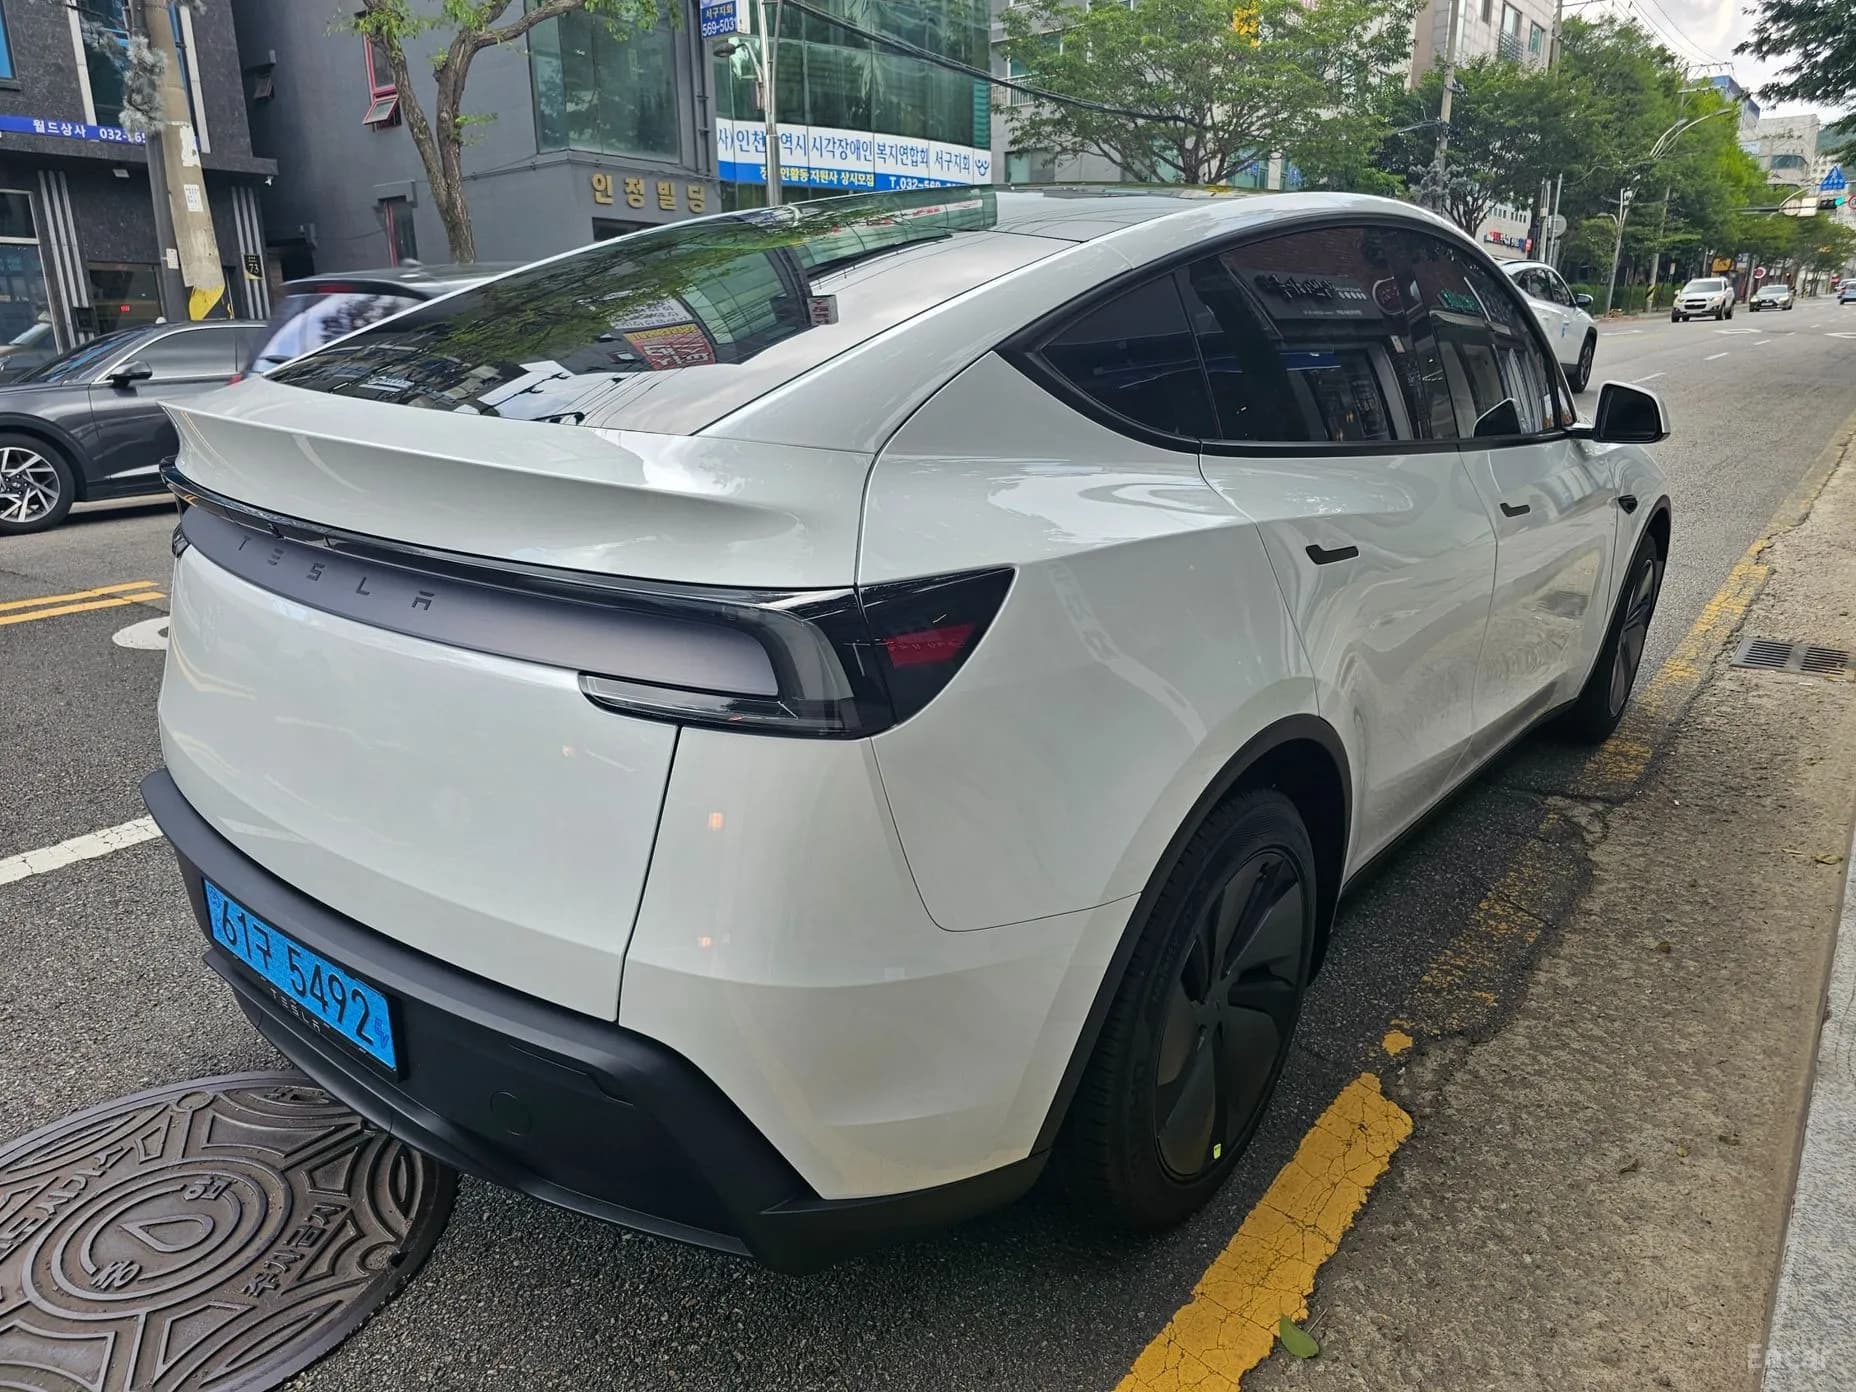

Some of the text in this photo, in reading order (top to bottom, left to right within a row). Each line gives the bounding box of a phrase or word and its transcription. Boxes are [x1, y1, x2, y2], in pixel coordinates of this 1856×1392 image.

[32, 118, 87, 138] 월드상사
[591, 173, 706, 215] 인정빌딩
[238, 535, 435, 611] TESLA
[221, 900, 375, 1046] 61구 5492
[270, 987, 321, 1033] TESLA
